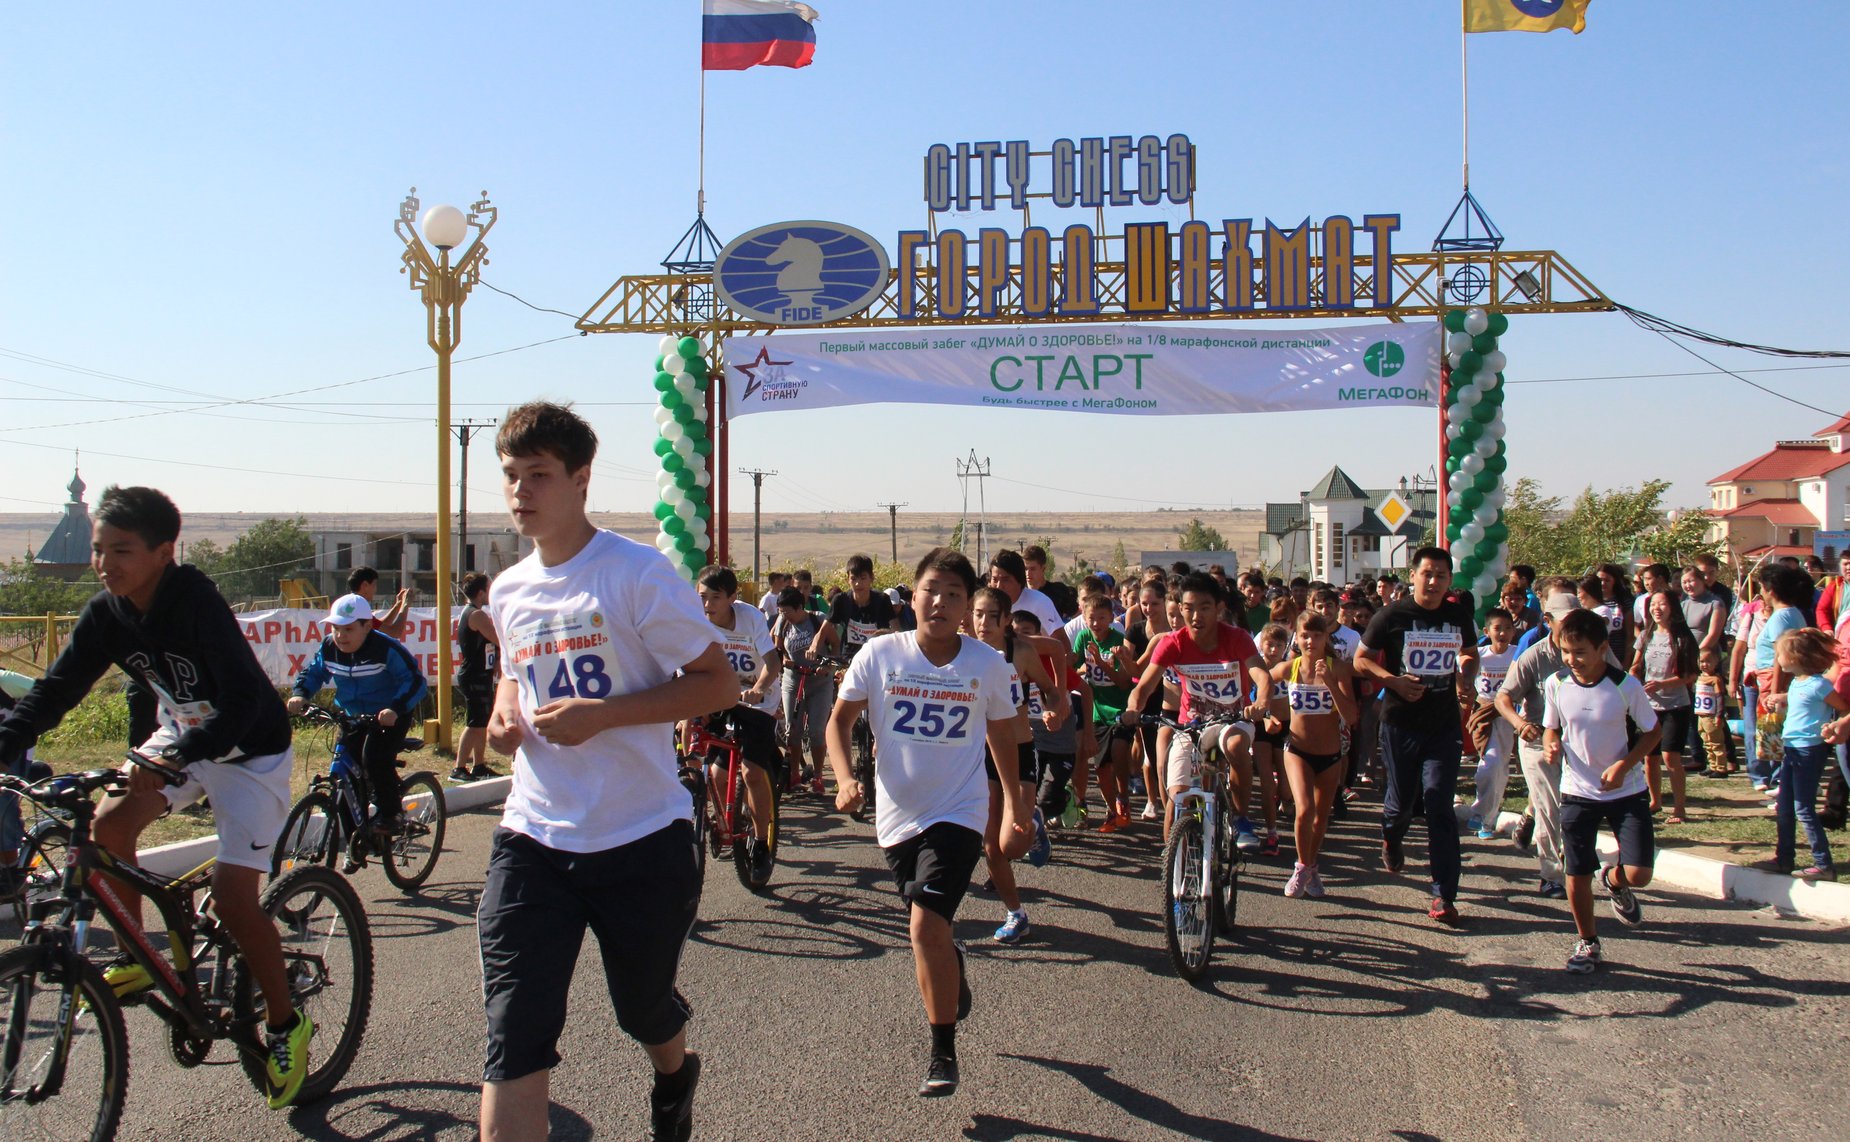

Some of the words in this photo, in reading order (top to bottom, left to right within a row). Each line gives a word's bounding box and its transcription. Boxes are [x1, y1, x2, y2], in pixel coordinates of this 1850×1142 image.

[928, 140, 1029, 212] CITY
[1052, 133, 1190, 208] CHESS
[898, 223, 1100, 319] ГОРОД
[1124, 213, 1401, 315] ШАХМАТ
[781, 306, 823, 322] FIDE
[819, 340, 865, 355] Первый
[871, 338, 929, 353] массовый
[932, 337, 967, 350] забег
[970, 334, 1025, 350] «ДУМАЙ
[1041, 334, 1123, 348] ЗДОРОВЬЕ!»
[1127, 336, 1142, 346] на
[1147, 334, 1167, 346] 1/8
[1170, 336, 1258, 349] марафонской
[1261, 337, 1331, 350] дистанции
[989, 353, 1153, 393] СТАРТ
[761, 389, 799, 401] СТРАНУ
[762, 380, 808, 391] СПОРТИВНУЮ
[982, 395, 1013, 405] Будь
[1016, 397, 1068, 408] быстрее
[1072, 400, 1078, 408] с
[1082, 397, 1157, 409] МегаФоном
[1409, 650, 1456, 670] 020
[1291, 690, 1334, 710] 355
[892, 700, 970, 738] 252
